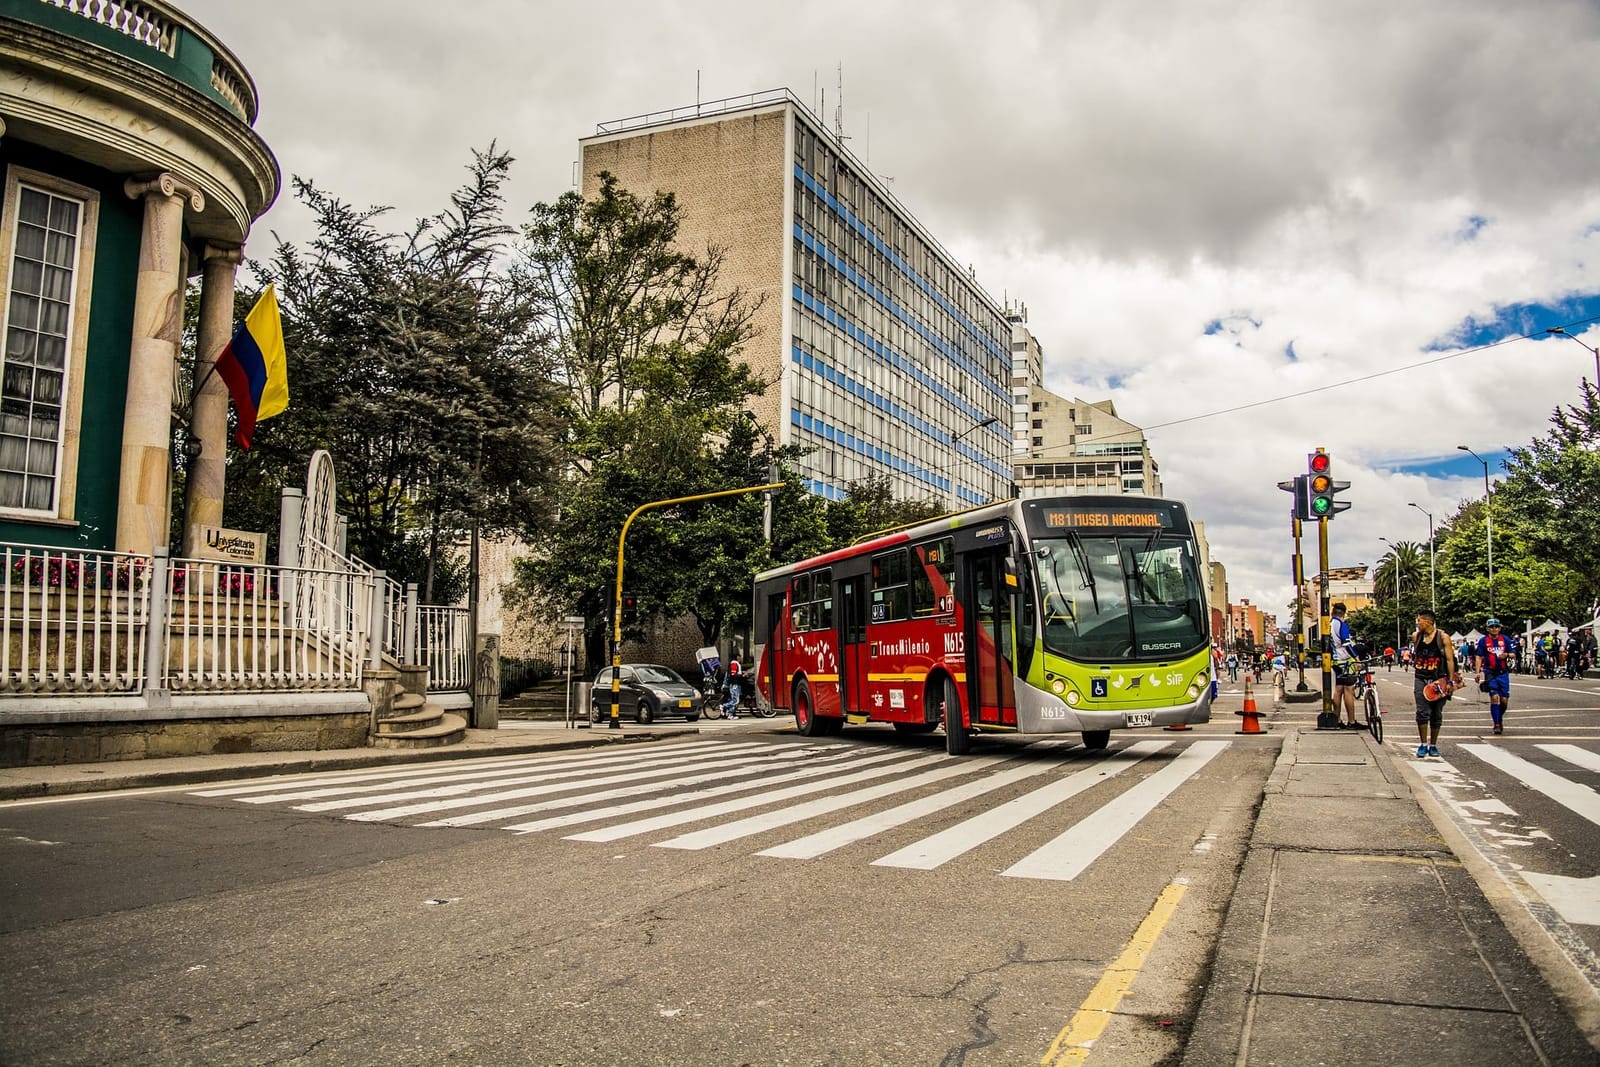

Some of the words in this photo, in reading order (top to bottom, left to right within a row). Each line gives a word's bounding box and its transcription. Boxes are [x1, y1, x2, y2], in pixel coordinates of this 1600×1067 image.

[1049, 513, 1071, 526] M81
[1074, 513, 1109, 526] MUSEO
[1112, 514, 1161, 526] NACIONAL
[879, 637, 930, 656] TransMilenio
[944, 632, 964, 653] N615
[1142, 642, 1182, 651] BUSSCAR
[1041, 706, 1065, 718] N615
